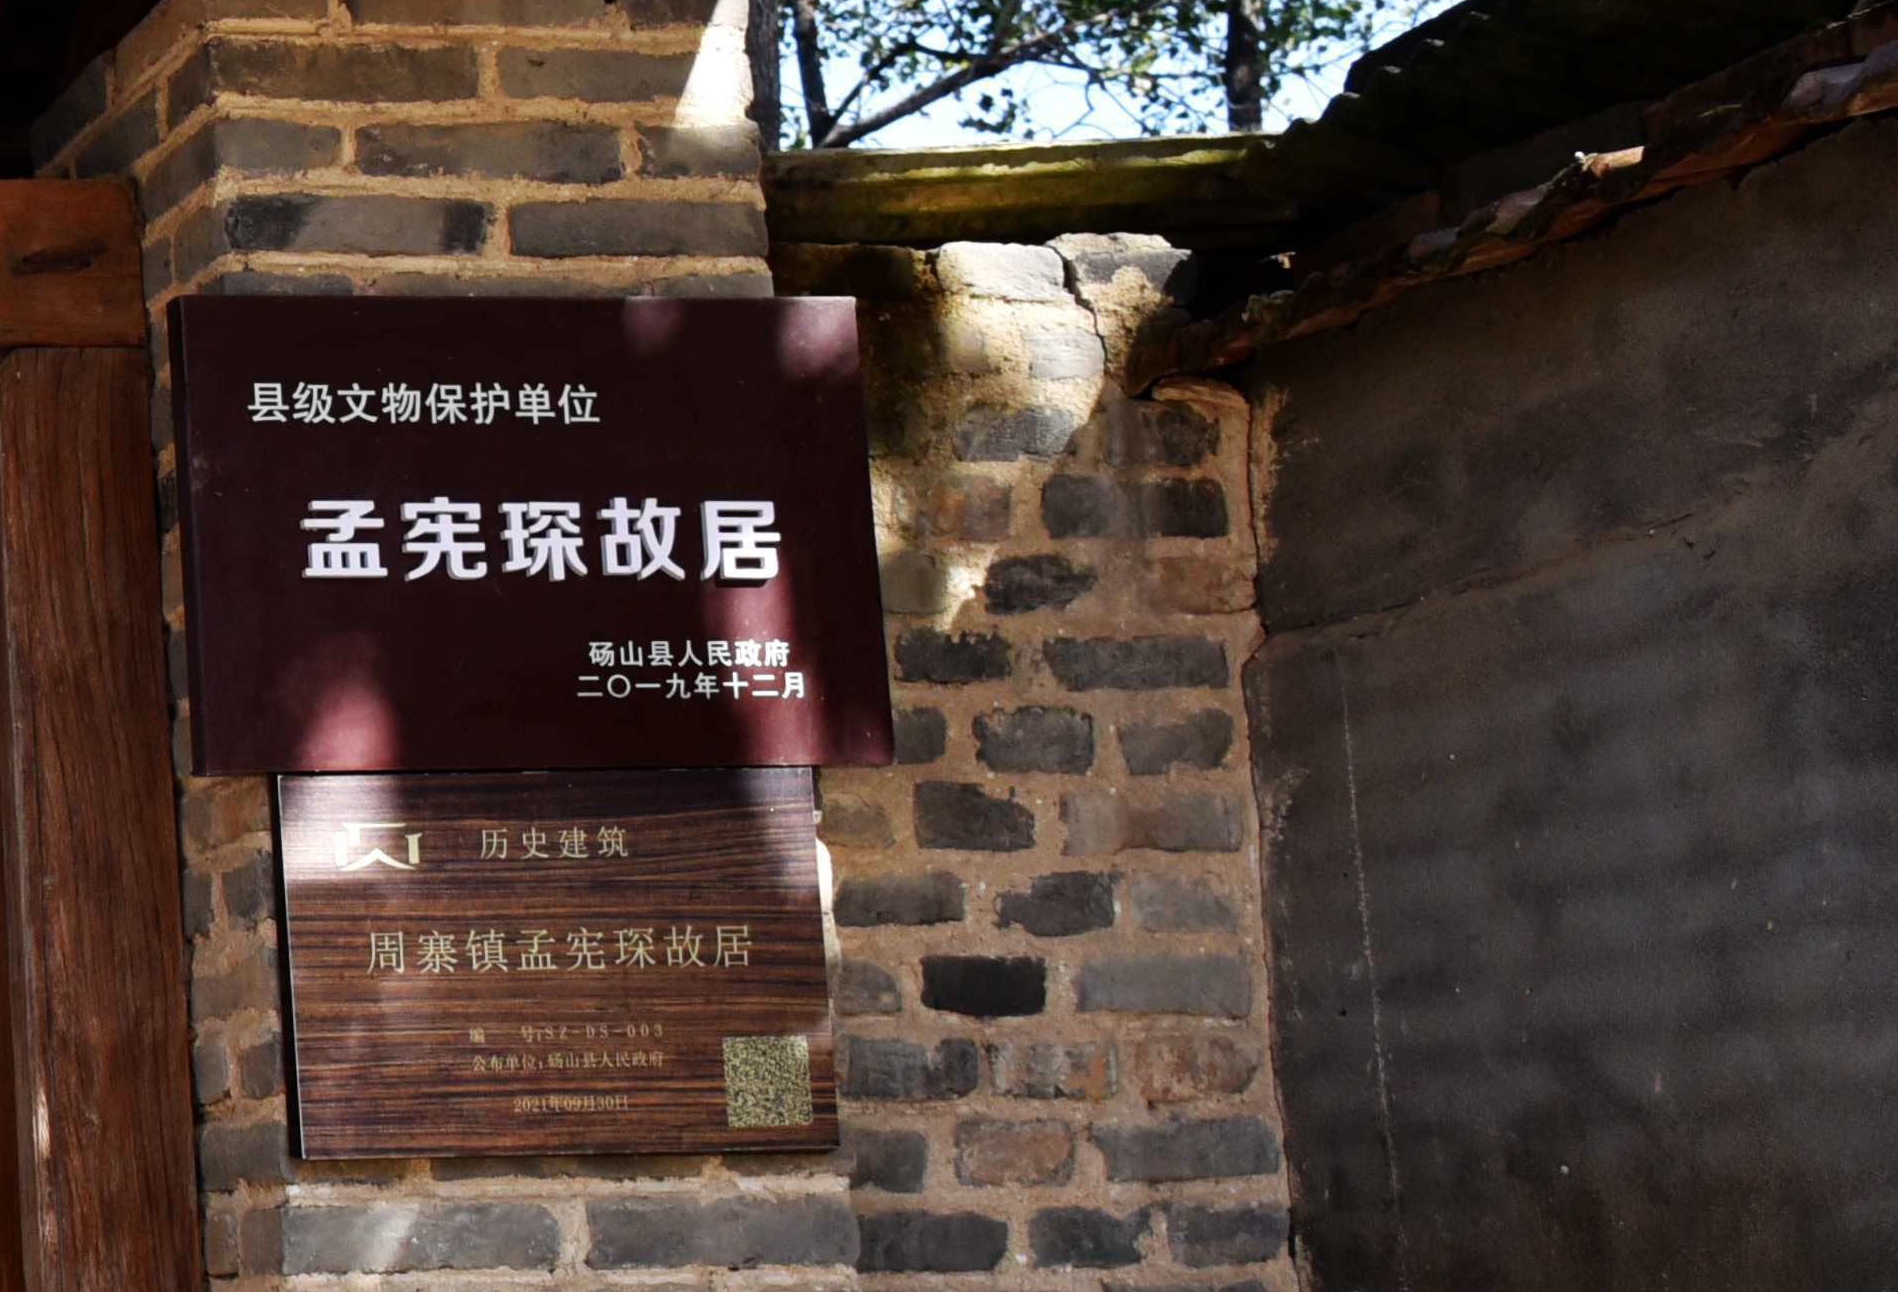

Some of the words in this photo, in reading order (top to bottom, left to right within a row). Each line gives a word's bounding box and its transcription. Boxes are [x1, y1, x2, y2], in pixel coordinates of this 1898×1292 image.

[247, 381, 602, 426] 县级文物保护单位
[301, 496, 783, 581] 孟宪琛故居
[588, 640, 790, 668] 砀山县人民政府
[480, 826, 629, 860] 历史建筑
[367, 924, 754, 975] 周寨镇孟宪琛故居
